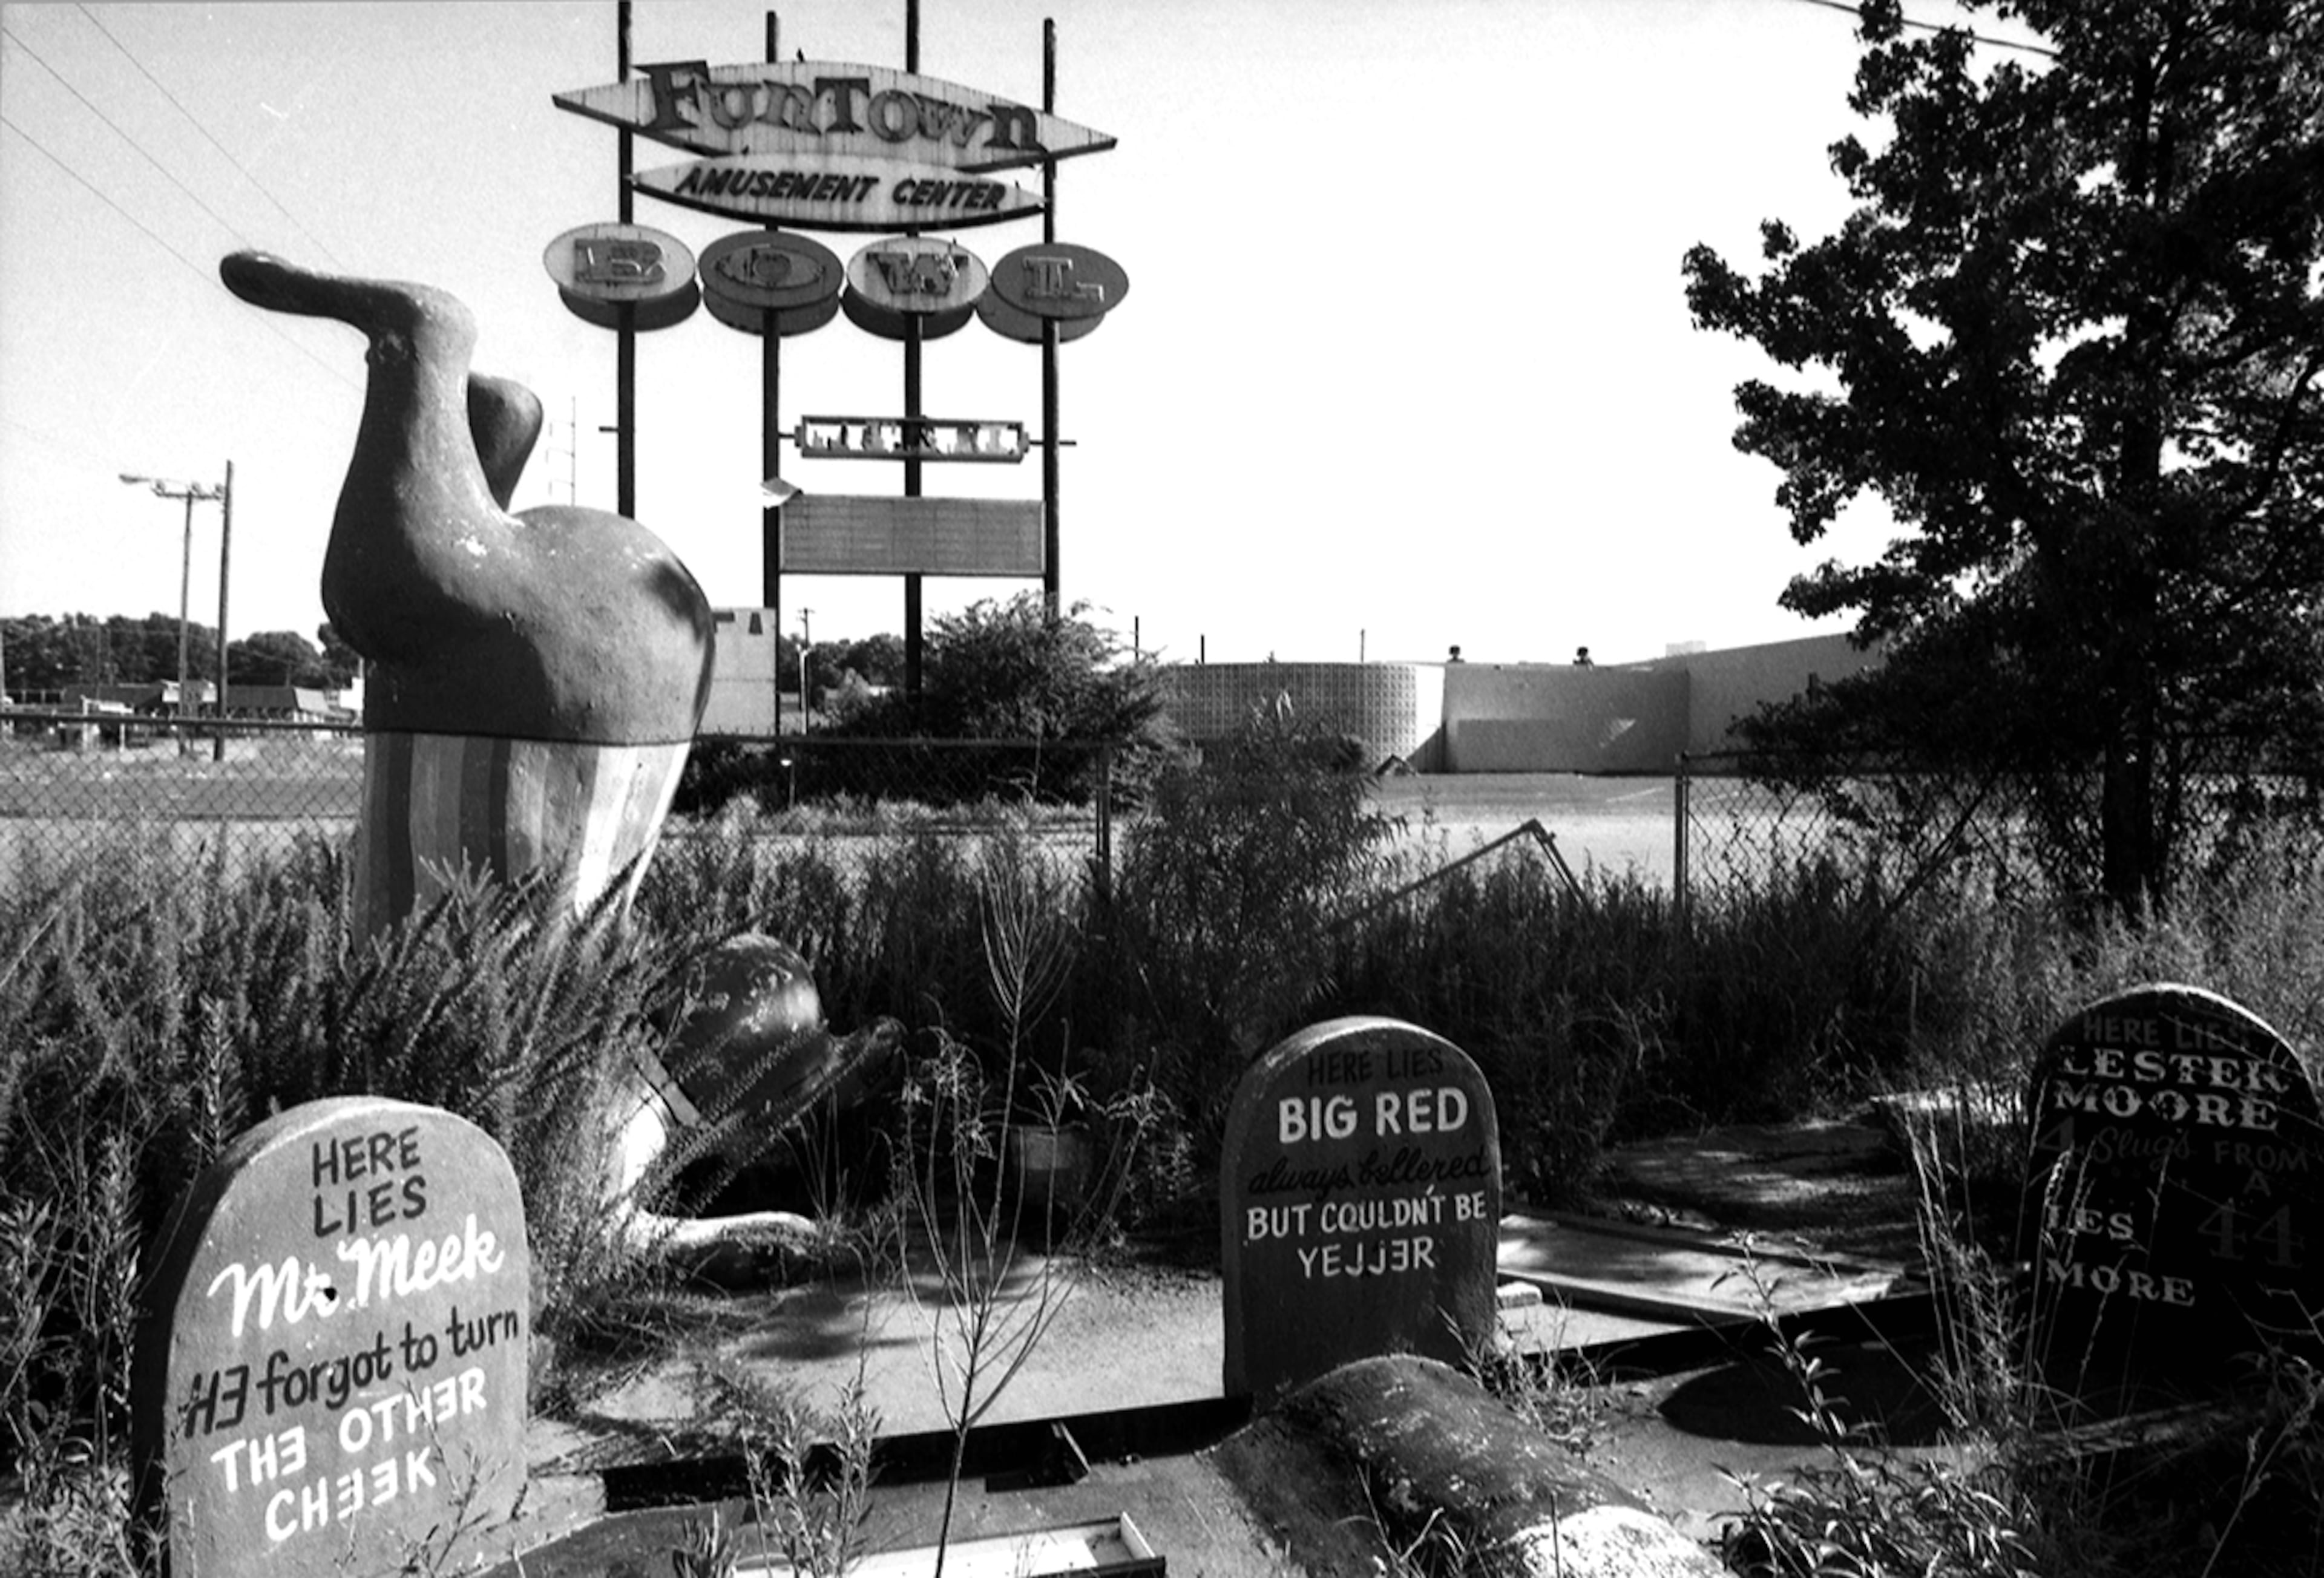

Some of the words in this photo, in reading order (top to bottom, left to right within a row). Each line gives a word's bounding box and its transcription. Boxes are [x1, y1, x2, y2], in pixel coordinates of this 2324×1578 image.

[633, 60, 1046, 151] FunTown
[674, 166, 879, 205] AMUSEMENT
[891, 178, 1008, 210] CENTER
[573, 236, 1105, 304] BOWL
[2083, 1012, 2161, 1046] HERE
[1308, 1050, 1373, 1086] HERE
[1387, 1048, 1443, 1080] LIES
[2059, 1046, 2290, 1093] LESTER
[1279, 1095, 1358, 1144] BIG
[1376, 1087, 1468, 1136] RED
[2054, 1080, 2278, 1131] MOORE
[313, 1126, 421, 1188] HERE
[1247, 1157, 1355, 1202] always
[1358, 1145, 1493, 1186] bellered
[2093, 1125, 2197, 1172] Slugs
[2213, 1139, 2309, 1173] FROM
[313, 1175, 428, 1237] LIES
[1247, 1203, 1312, 1240] BUT
[1454, 1190, 1487, 1221] BE
[336, 1213, 505, 1309] Meek
[2045, 1258, 2196, 1307] MORE
[257, 1330, 393, 1410] forgot
[399, 1322, 439, 1373] to
[445, 1306, 520, 1358] turn
